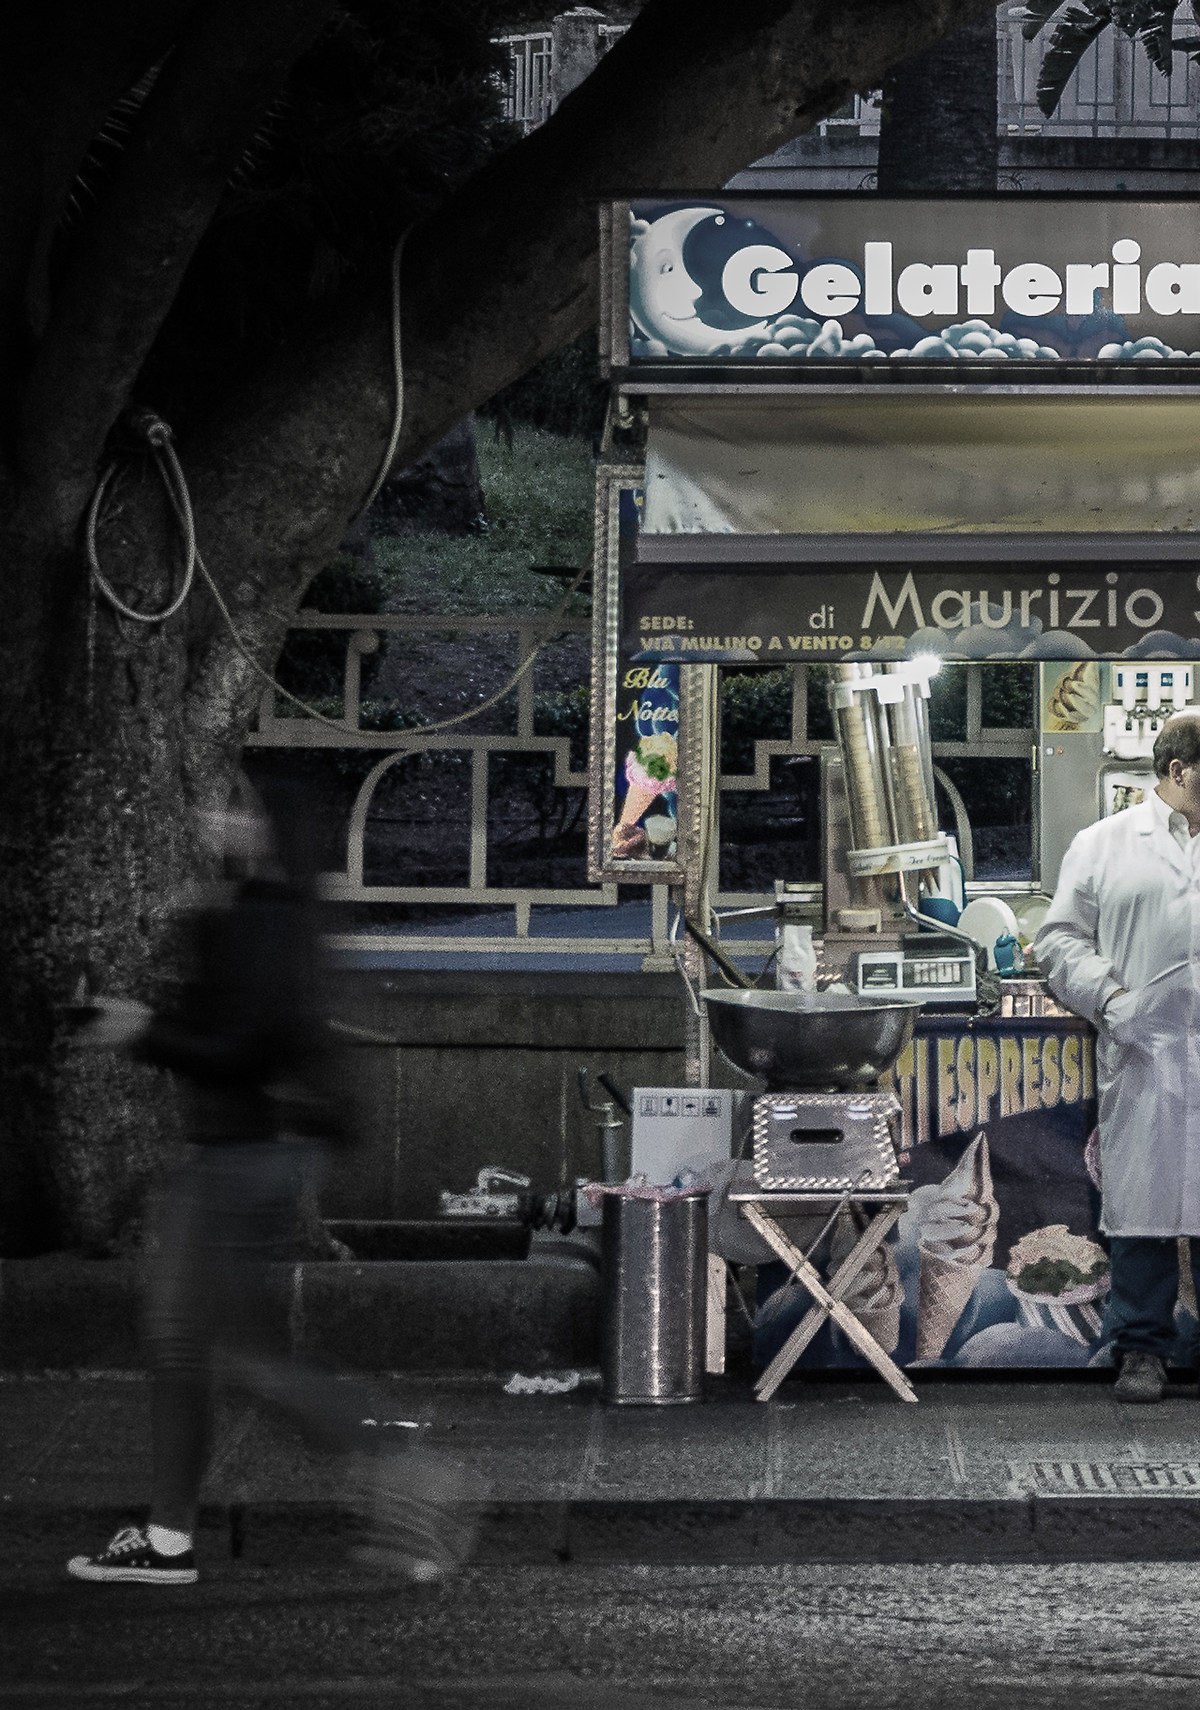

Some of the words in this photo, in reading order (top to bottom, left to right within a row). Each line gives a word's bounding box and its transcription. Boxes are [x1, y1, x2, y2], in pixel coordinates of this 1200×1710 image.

[809, 604, 834, 629] di
[861, 570, 1164, 629] Maurizio
[640, 616, 694, 630] SEDE:
[641, 636, 674, 650] VIA
[681, 636, 762, 650] MULINO
[768, 636, 783, 650] A
[789, 636, 853, 650] VENTO
[622, 667, 669, 689] Blu
[617, 699, 679, 721] Notte
